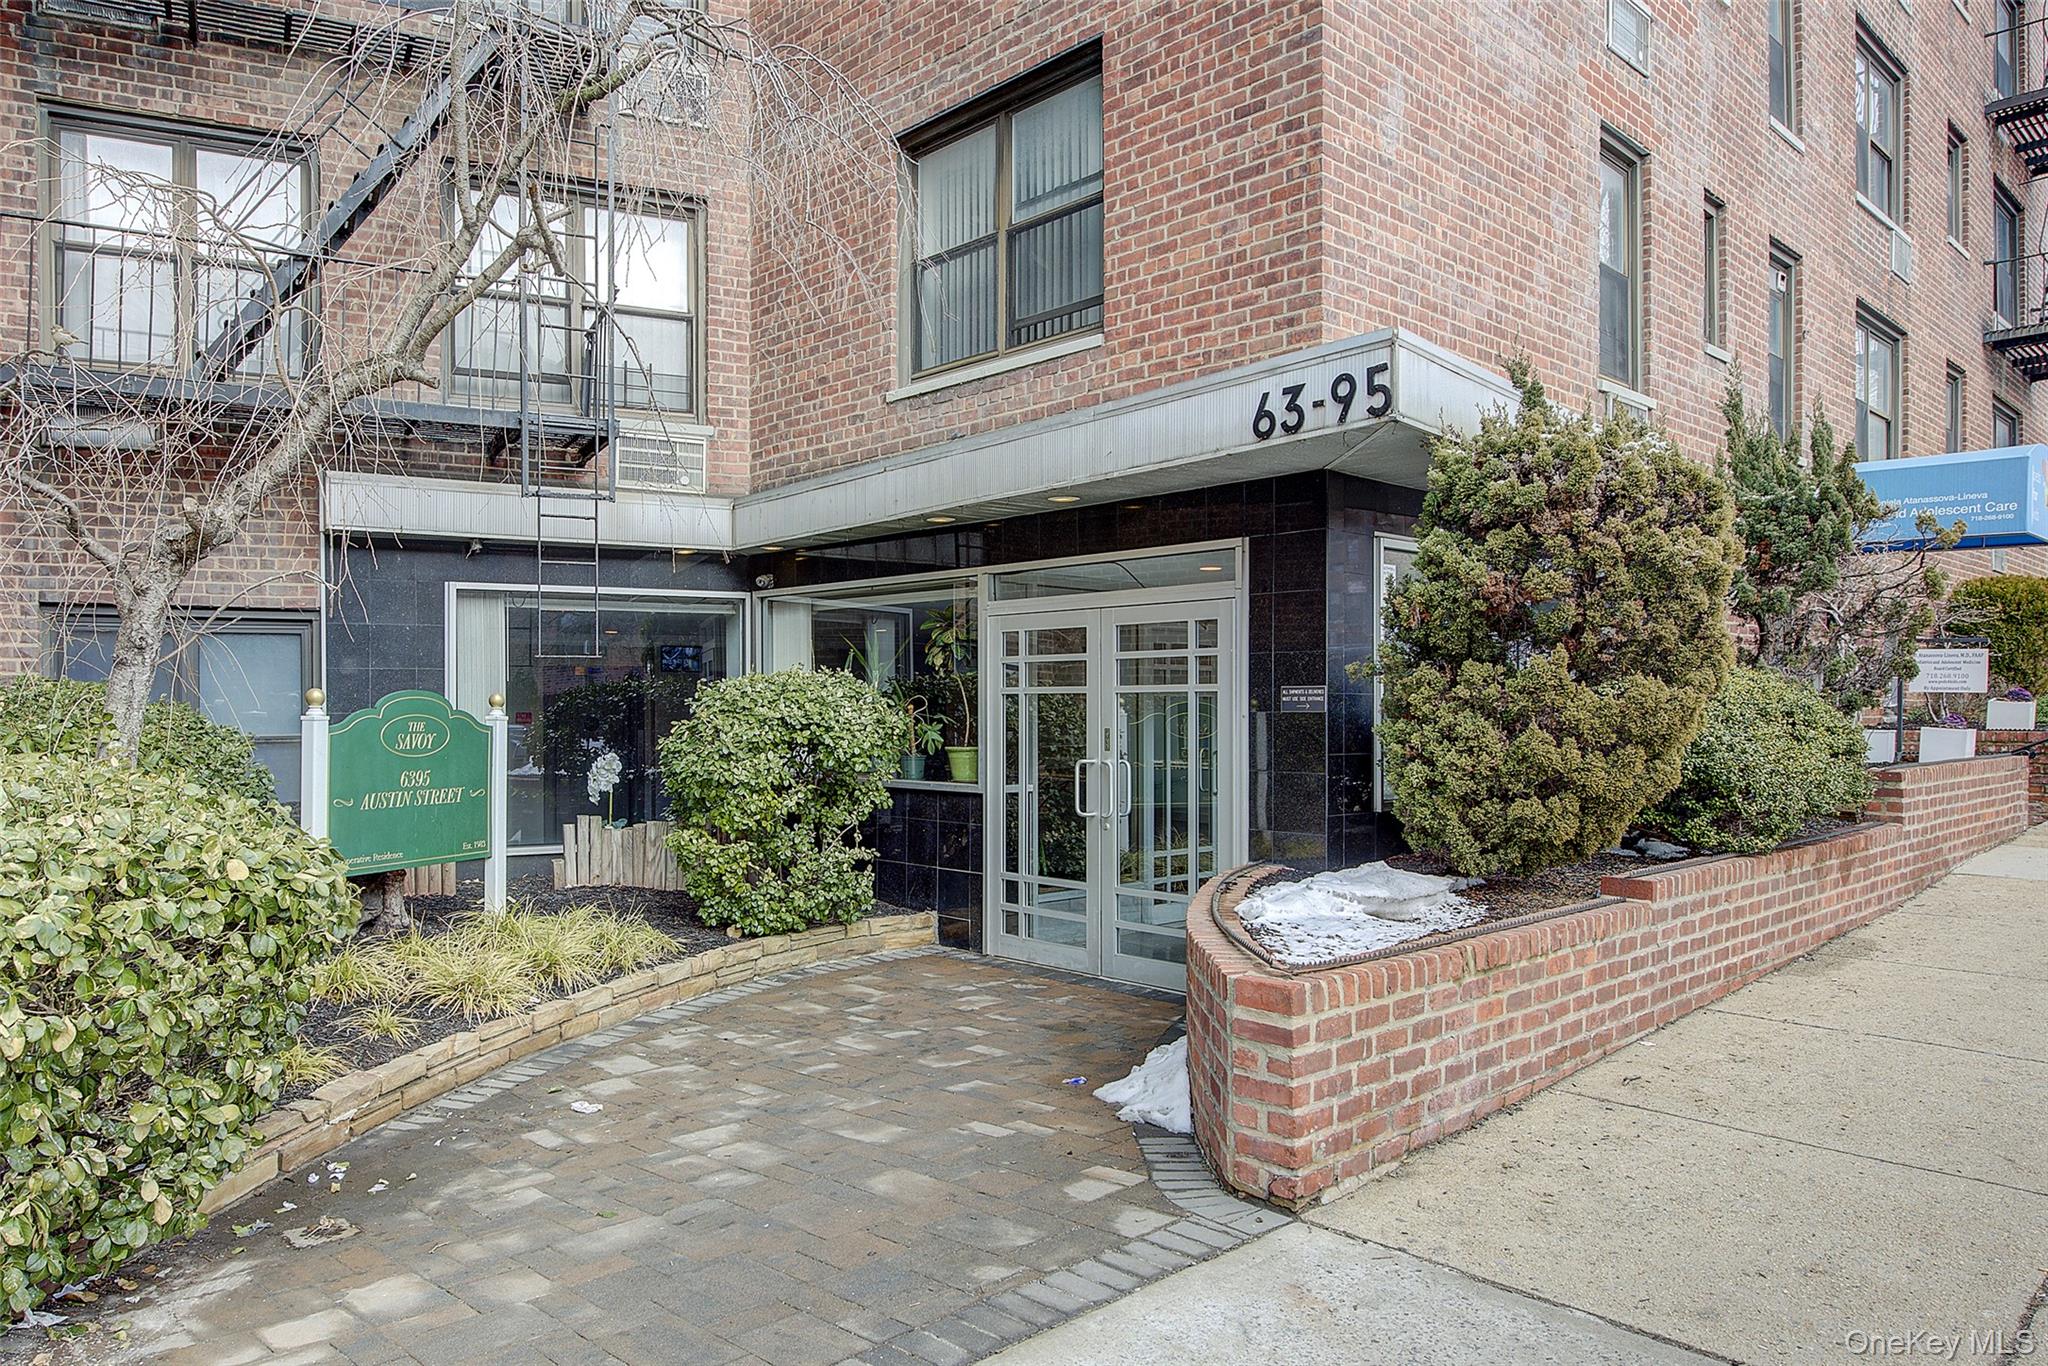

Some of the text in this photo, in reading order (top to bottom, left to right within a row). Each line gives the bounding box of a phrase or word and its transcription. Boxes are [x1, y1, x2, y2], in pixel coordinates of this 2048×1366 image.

[1253, 362, 1392, 440] 63-95
[1903, 492, 1988, 505] Atanassova-Lineva
[1985, 501, 2018, 513] Care
[407, 721, 426, 732] THE
[395, 733, 436, 751] SAVOY
[400, 770, 431, 788] 6395
[360, 786, 465, 811] AUSTIN STREET
[373, 851, 404, 862] Residence
